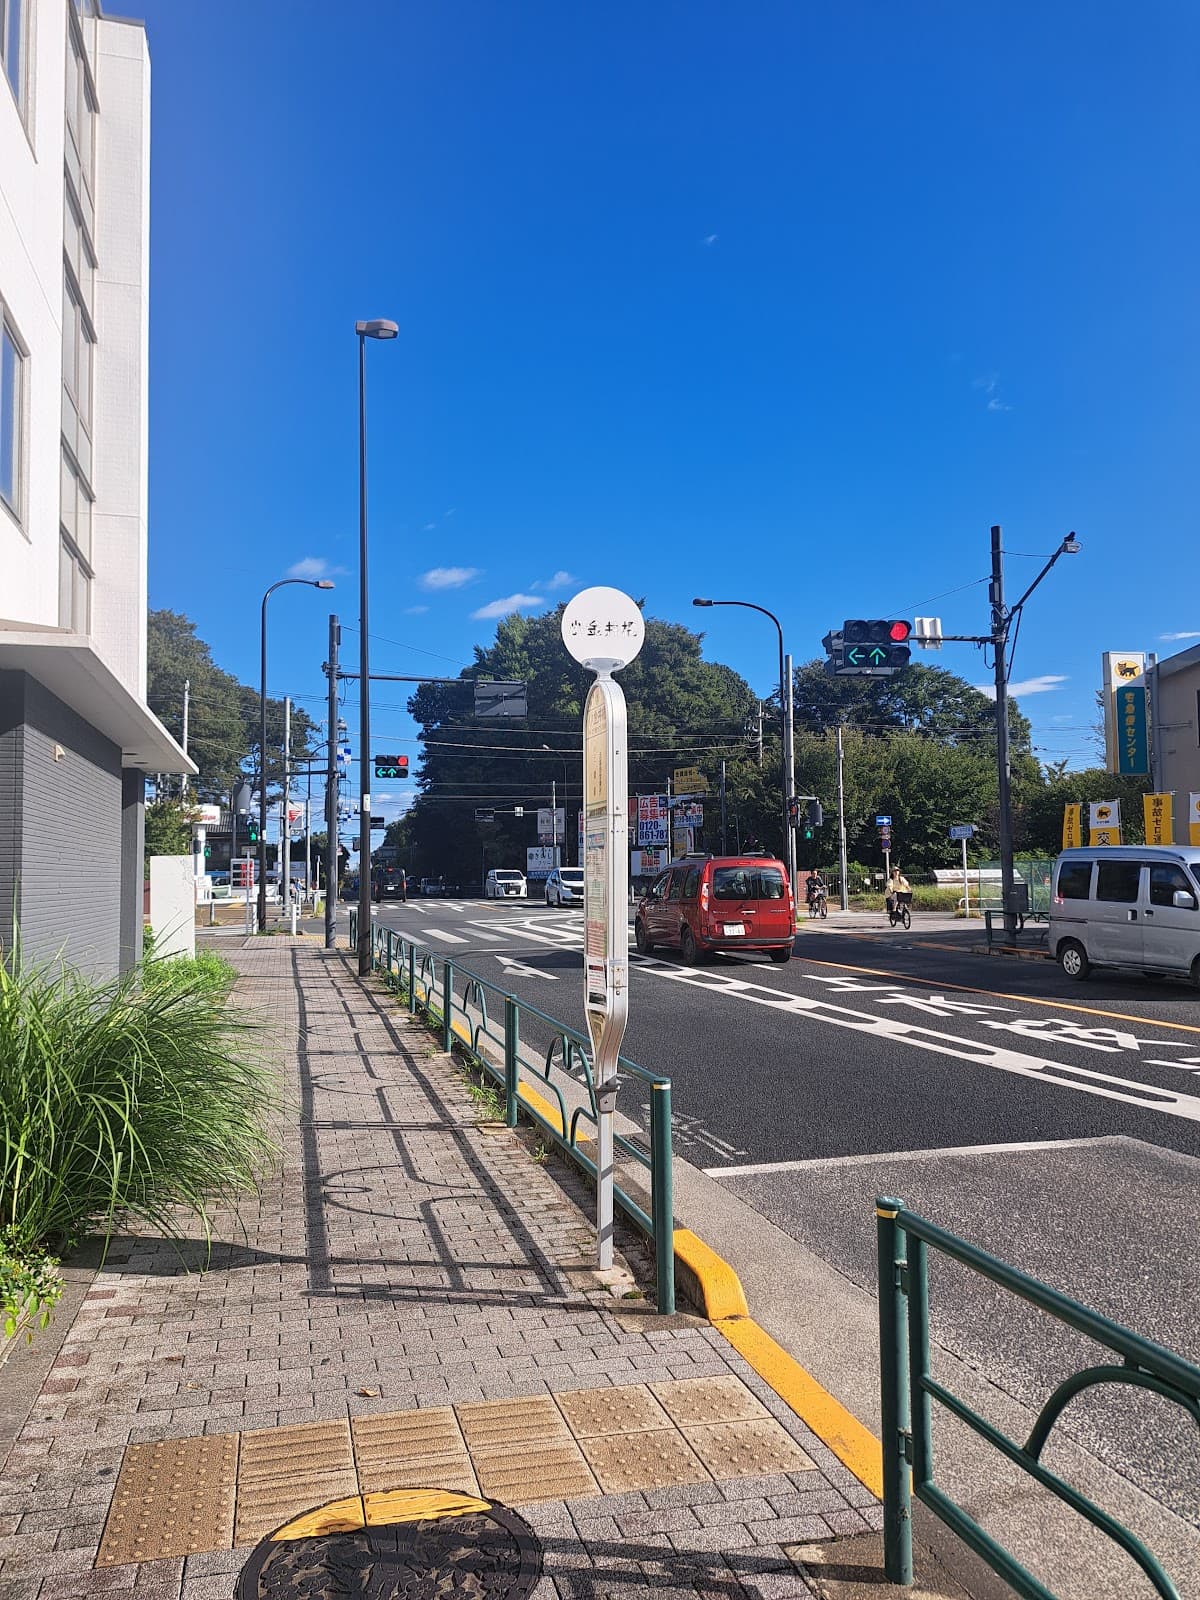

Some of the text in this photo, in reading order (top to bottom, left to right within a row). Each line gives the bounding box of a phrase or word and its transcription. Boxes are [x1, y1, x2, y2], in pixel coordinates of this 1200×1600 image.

[1124, 692, 1136, 768] 宅急便センター
[640, 821, 661, 831] 0120-
[802, 974, 1200, 1076] 上水桜
